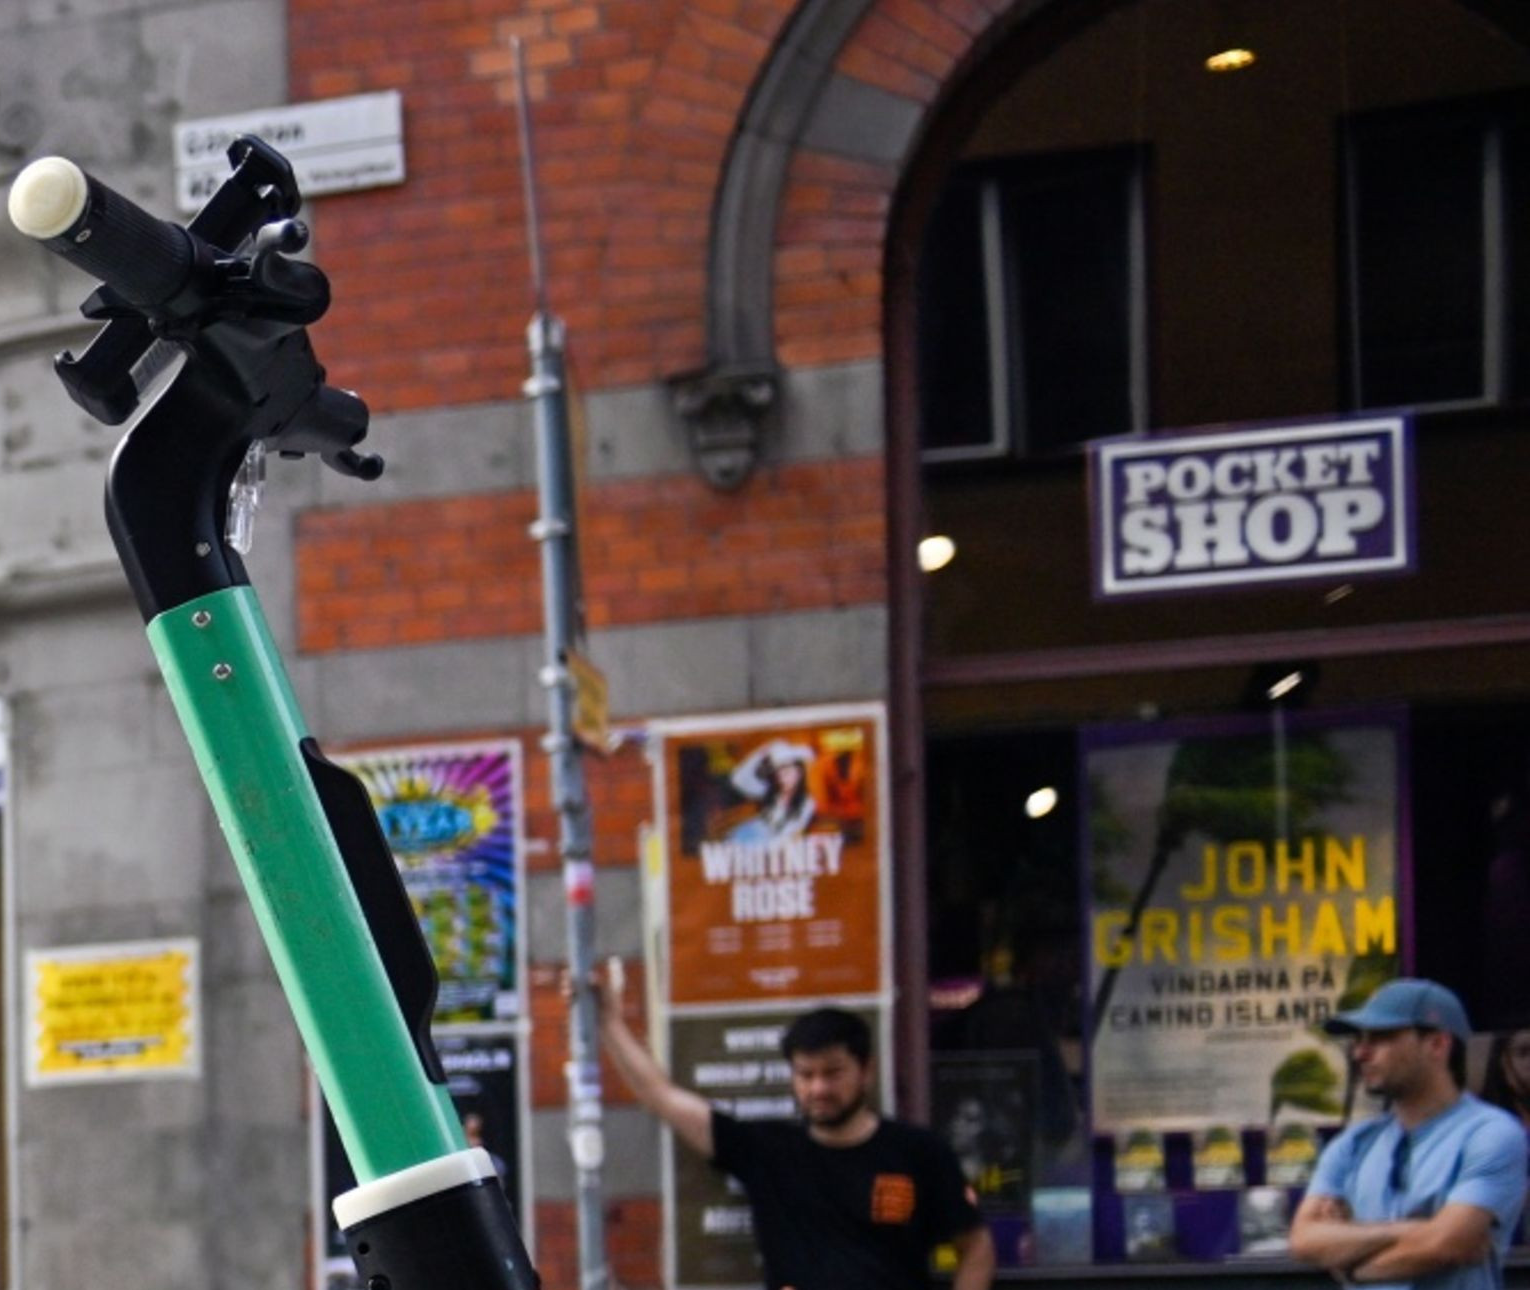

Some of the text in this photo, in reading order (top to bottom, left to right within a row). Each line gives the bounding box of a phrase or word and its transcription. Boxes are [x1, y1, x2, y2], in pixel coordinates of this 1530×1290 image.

[1123, 440, 1381, 503] POCKET
[1120, 487, 1385, 575] SHOP
[700, 833, 844, 885] WHITNEY
[1179, 835, 1367, 900] JOHN
[732, 877, 815, 922] ROSE
[1092, 896, 1397, 967] GRISHAM
[1150, 956, 1336, 996] VINDARNA PÅ
[1110, 997, 1331, 1032] CAMINO ISLAND
